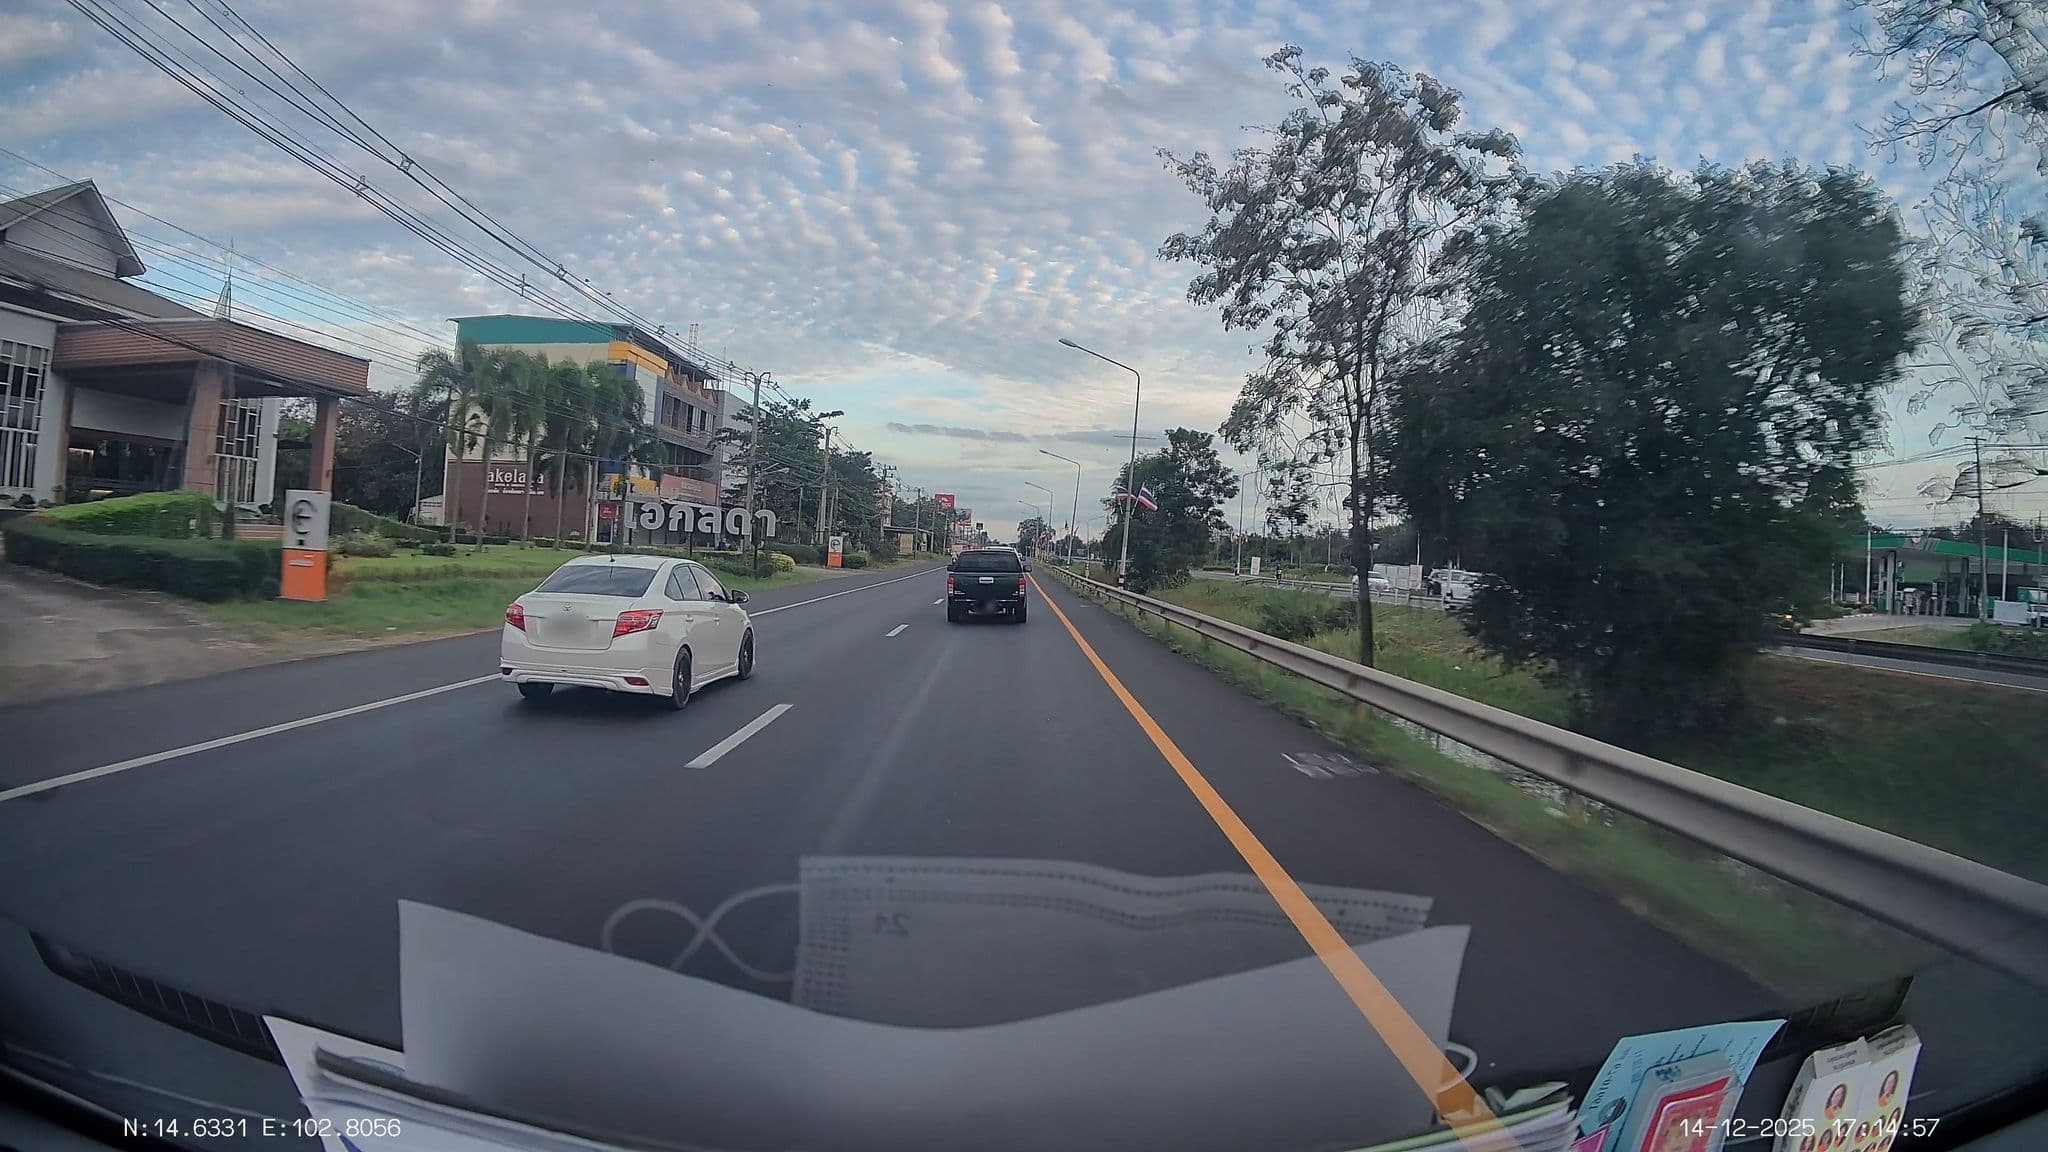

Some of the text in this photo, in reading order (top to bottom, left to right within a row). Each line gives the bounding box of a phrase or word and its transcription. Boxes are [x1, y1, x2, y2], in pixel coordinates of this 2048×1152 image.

[487, 468, 545, 484] akelaa
[624, 501, 777, 538] เอกลดา
